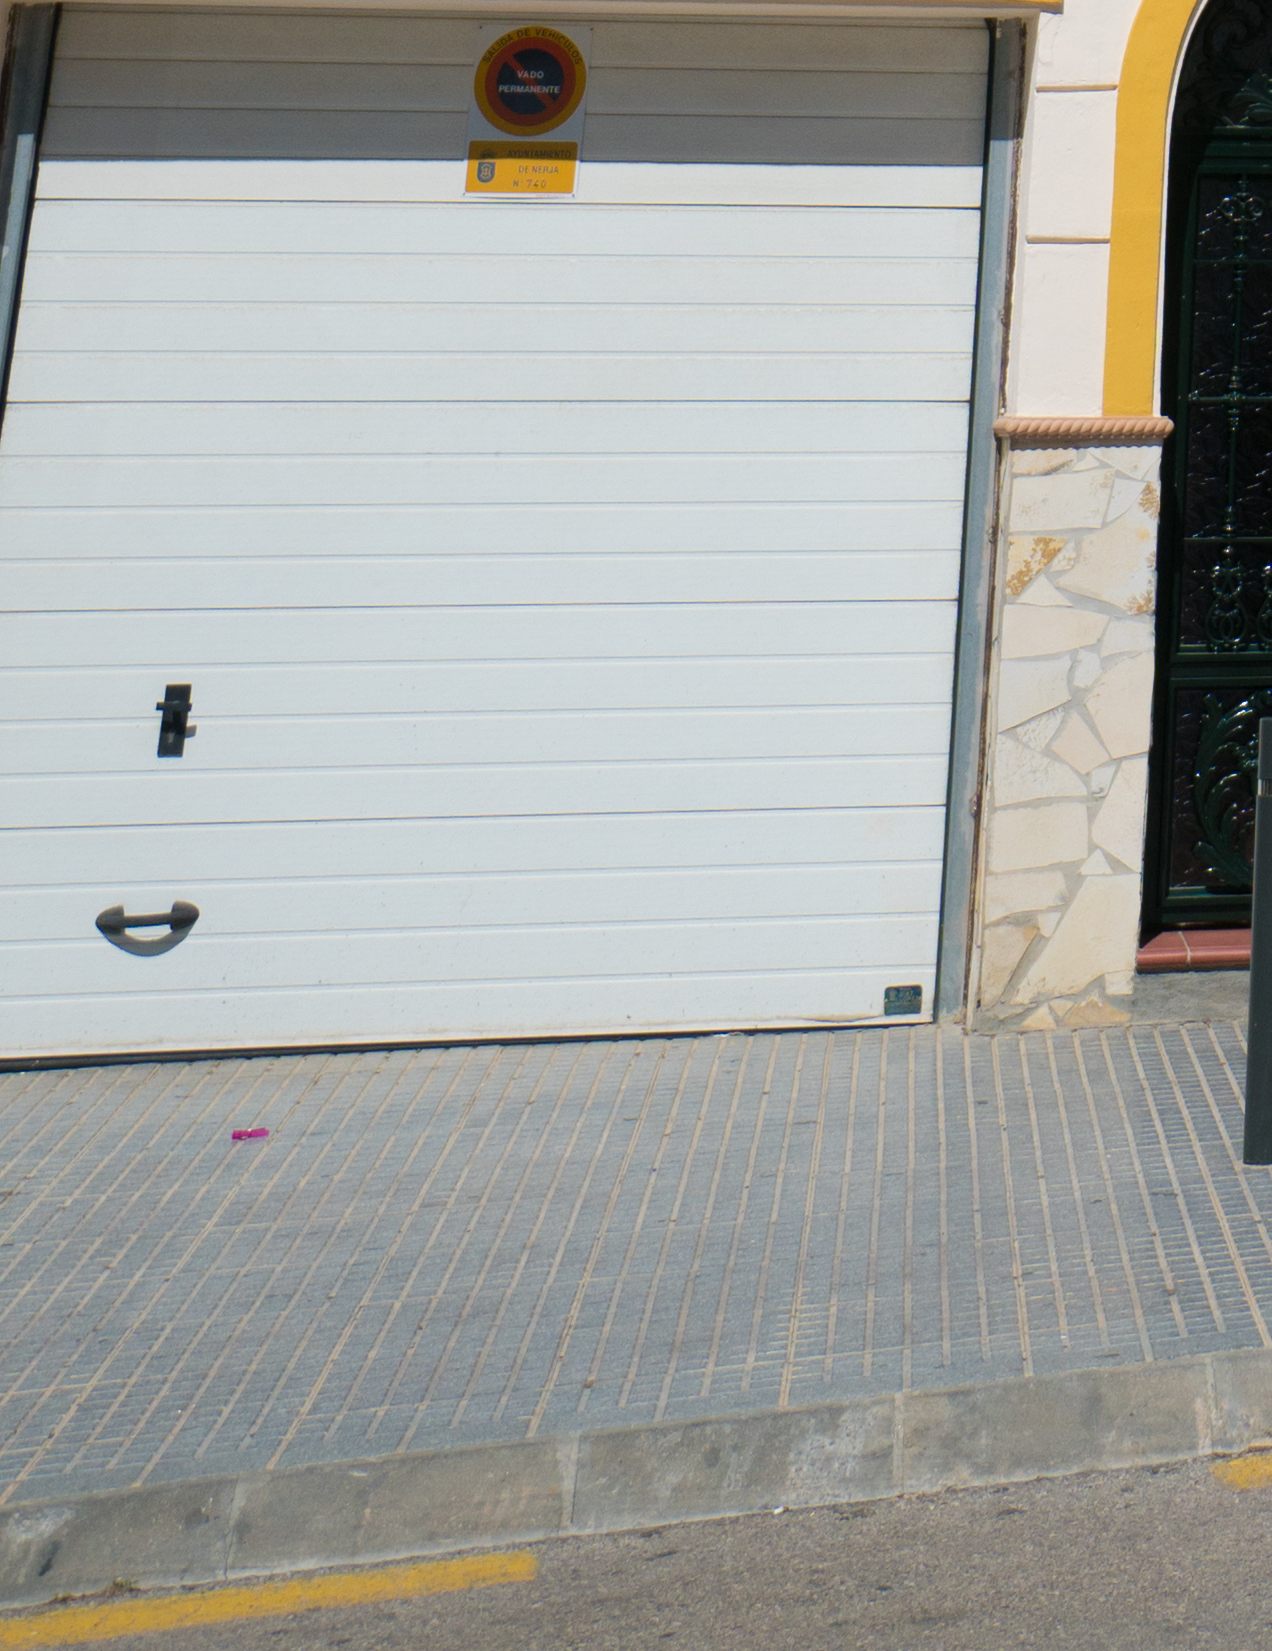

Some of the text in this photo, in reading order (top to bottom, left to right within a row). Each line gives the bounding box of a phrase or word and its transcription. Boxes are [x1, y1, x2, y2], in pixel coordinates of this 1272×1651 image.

[482, 28, 583, 65] SALIDA DE VEHICULOS
[517, 70, 545, 79] VADO
[499, 84, 561, 94] PERMANENTE
[507, 149, 572, 159] AYUNTAMIENTO
[518, 165, 560, 175] DE NERJA
